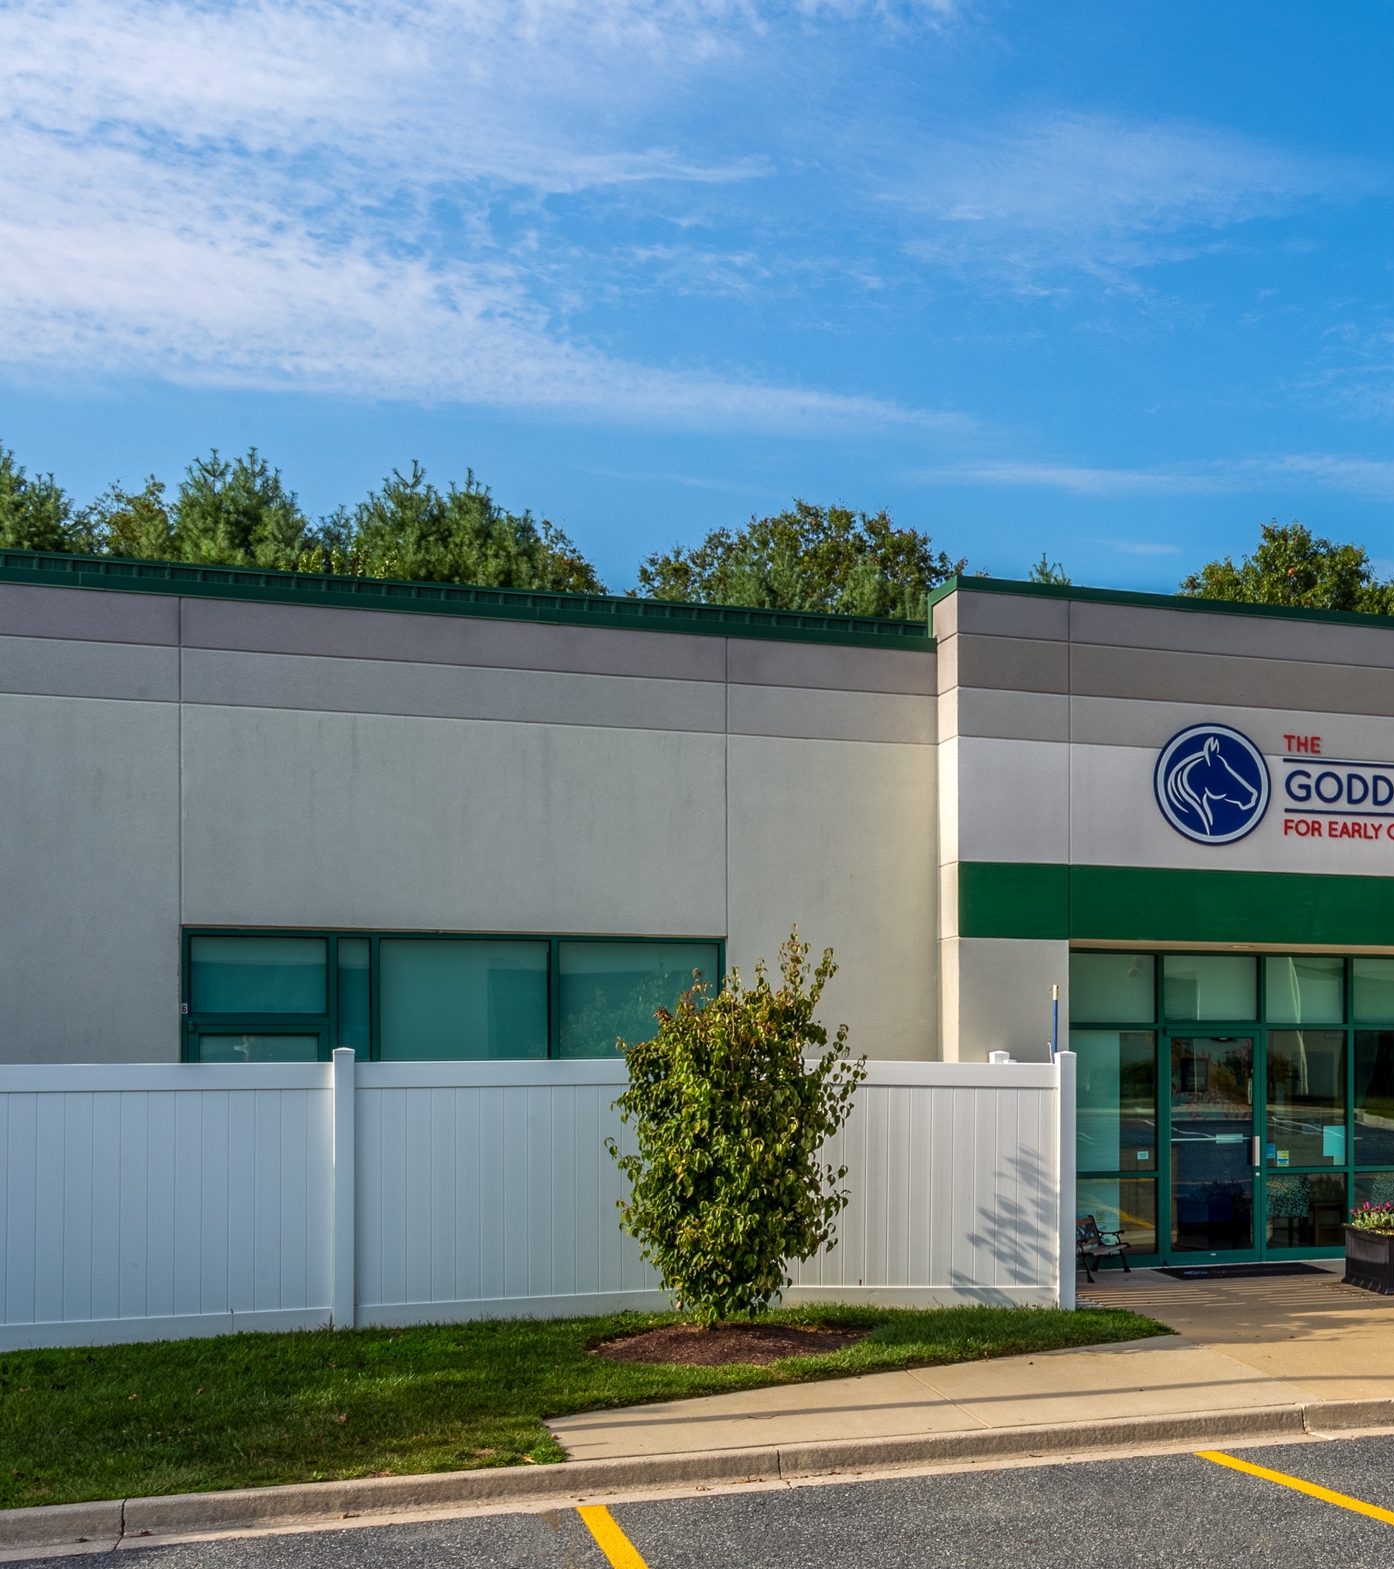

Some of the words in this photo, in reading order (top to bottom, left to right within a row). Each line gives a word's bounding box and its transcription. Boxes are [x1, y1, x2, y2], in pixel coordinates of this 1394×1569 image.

[1283, 734, 1322, 755] THE
[1283, 818, 1323, 838] FOR
[1327, 820, 1383, 841] EARLY
